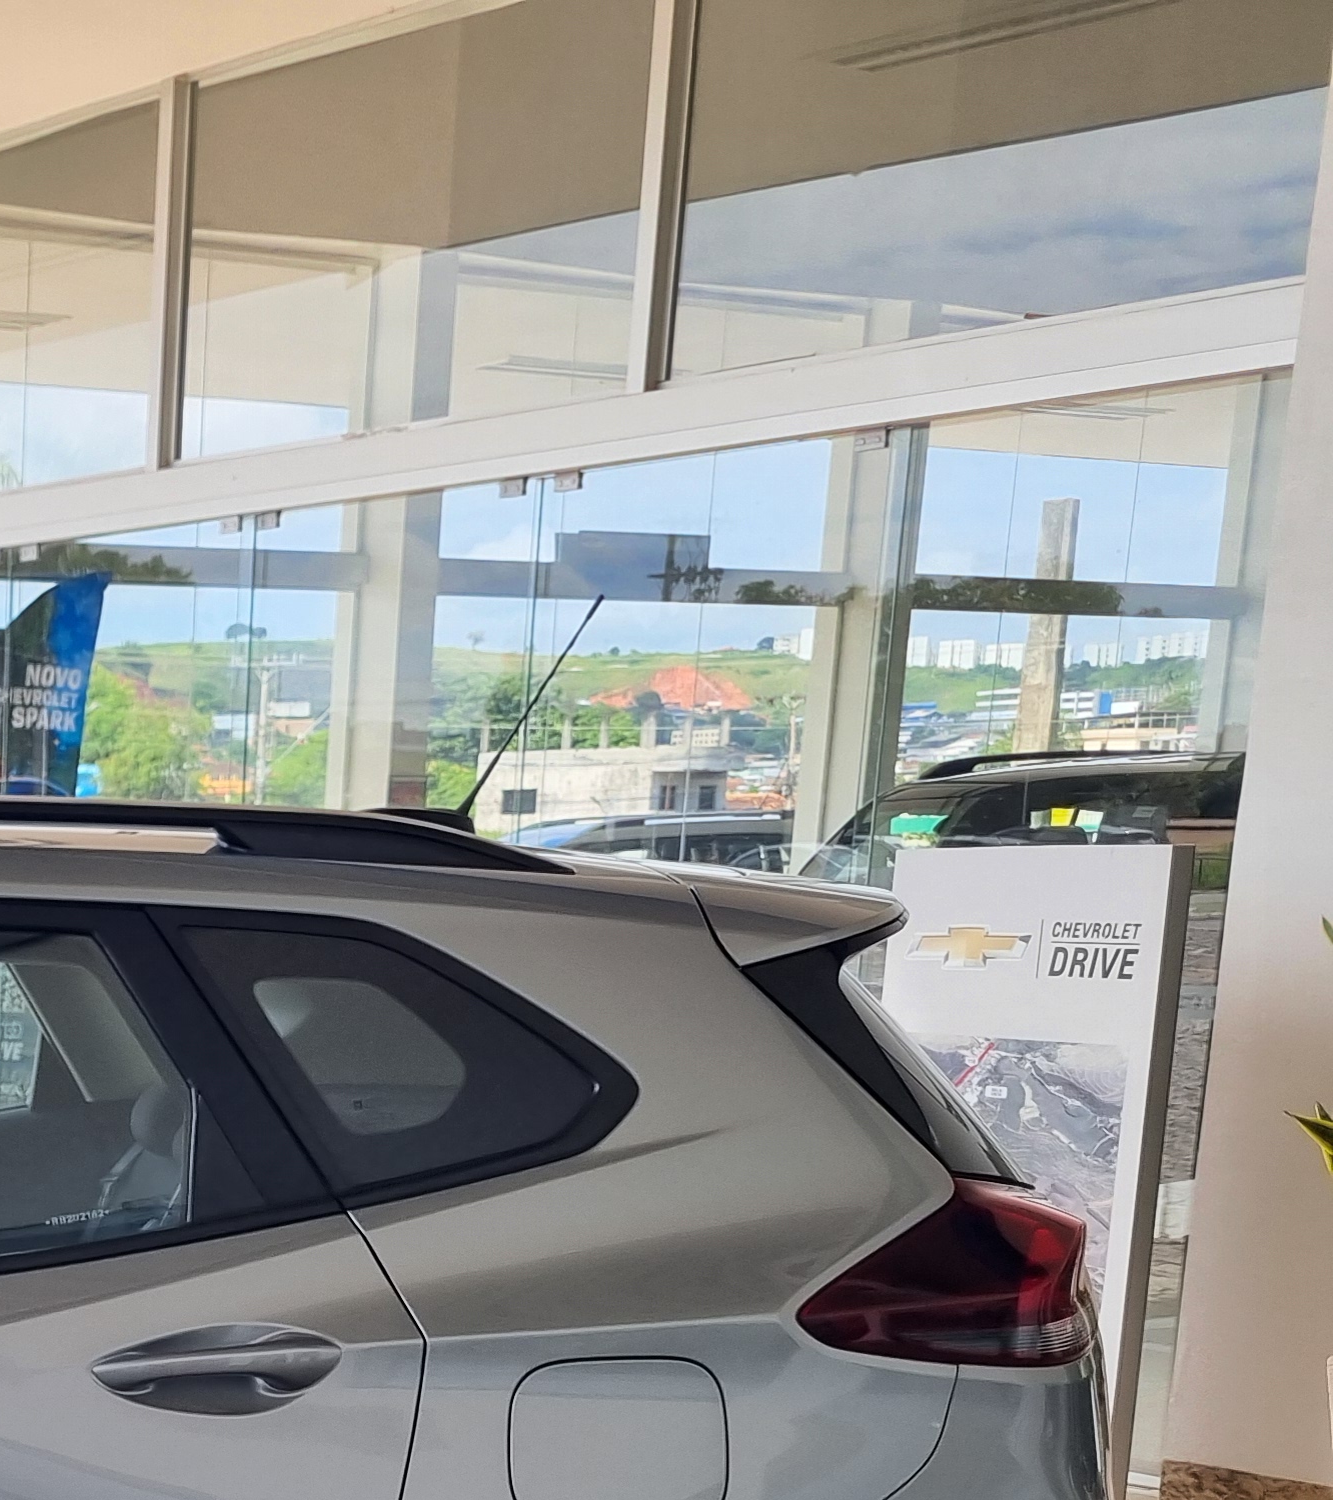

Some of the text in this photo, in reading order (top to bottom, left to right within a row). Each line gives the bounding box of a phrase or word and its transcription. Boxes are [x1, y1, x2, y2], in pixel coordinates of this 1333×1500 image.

[24, 663, 82, 690] NOVO
[11, 706, 78, 732] SPARK
[1052, 921, 1143, 940] CHEVROLET
[1047, 946, 1140, 980] DRIVE
